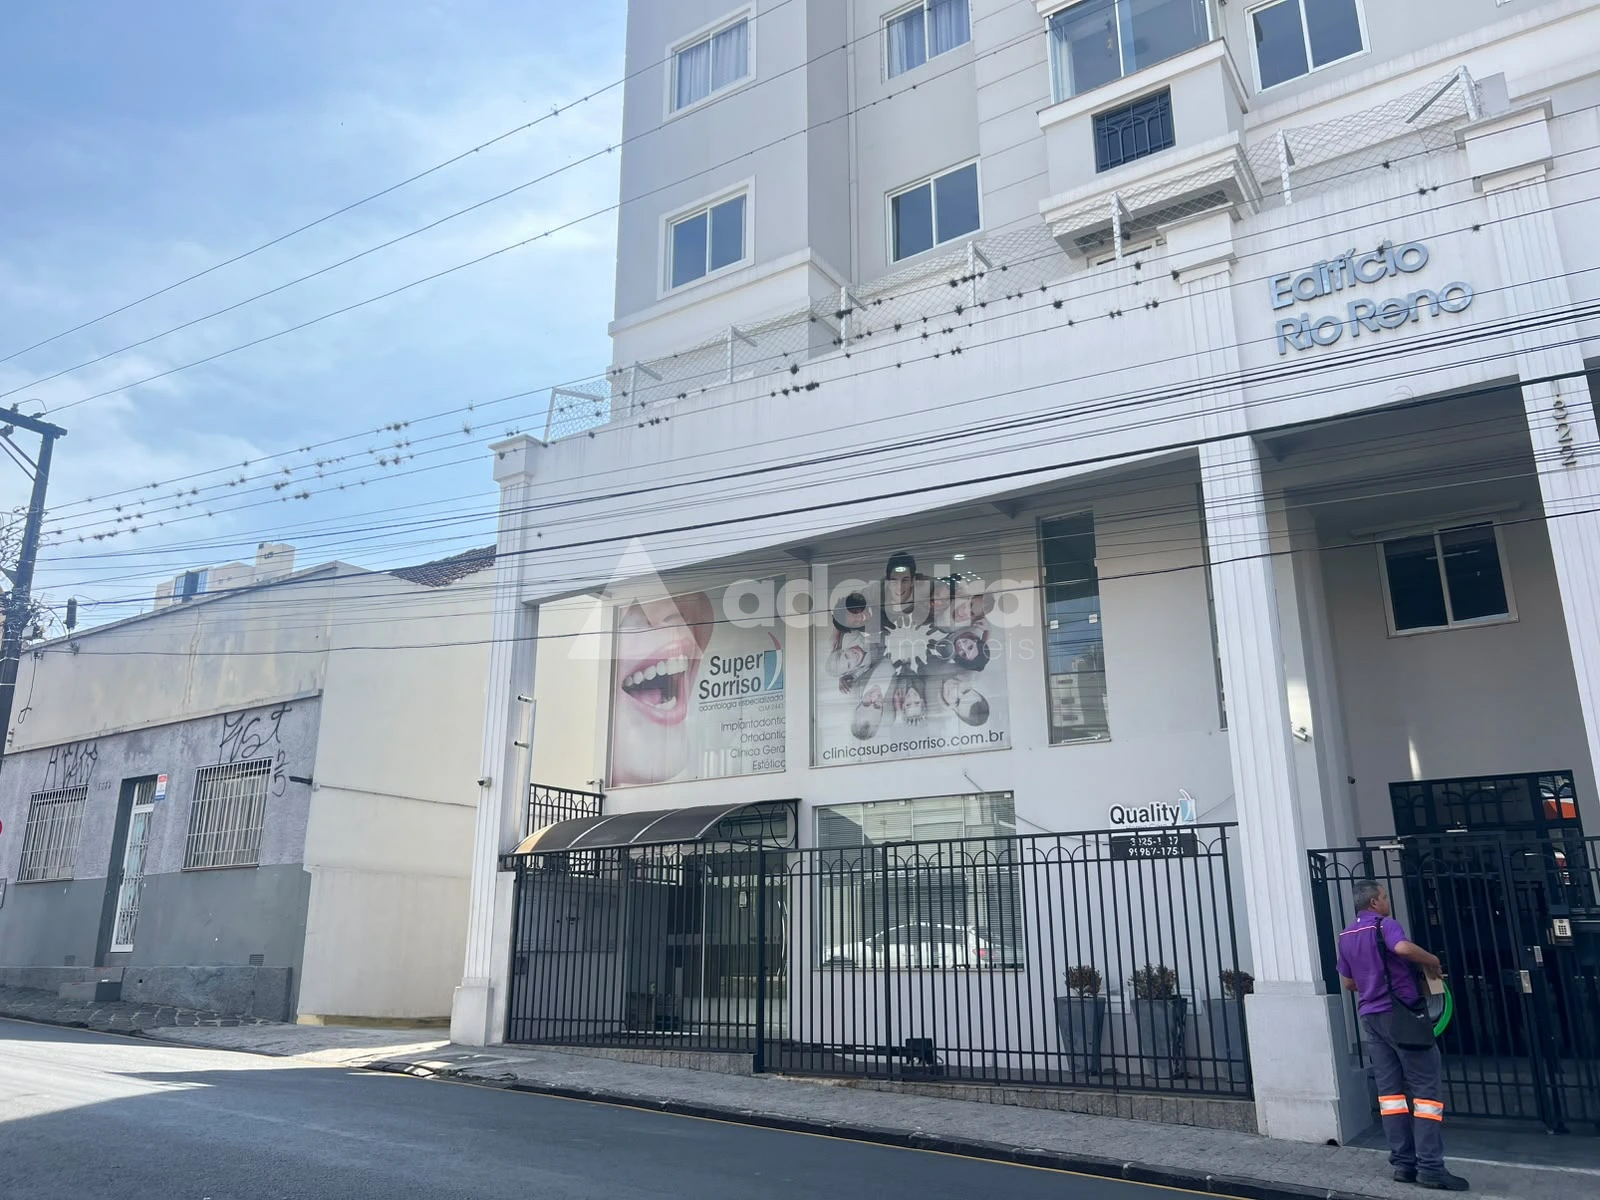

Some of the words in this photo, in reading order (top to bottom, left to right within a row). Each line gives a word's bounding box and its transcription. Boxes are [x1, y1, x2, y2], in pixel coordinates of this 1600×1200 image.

[1268, 240, 1429, 311] Edifício
[1275, 312, 1343, 356] Rio
[1346, 281, 1474, 338] Reno
[709, 653, 763, 677] Super
[699, 675, 762, 700] Sorriso
[822, 730, 1005, 760] clinicasupersorriso.com.br
[1110, 803, 1180, 826] Quality
